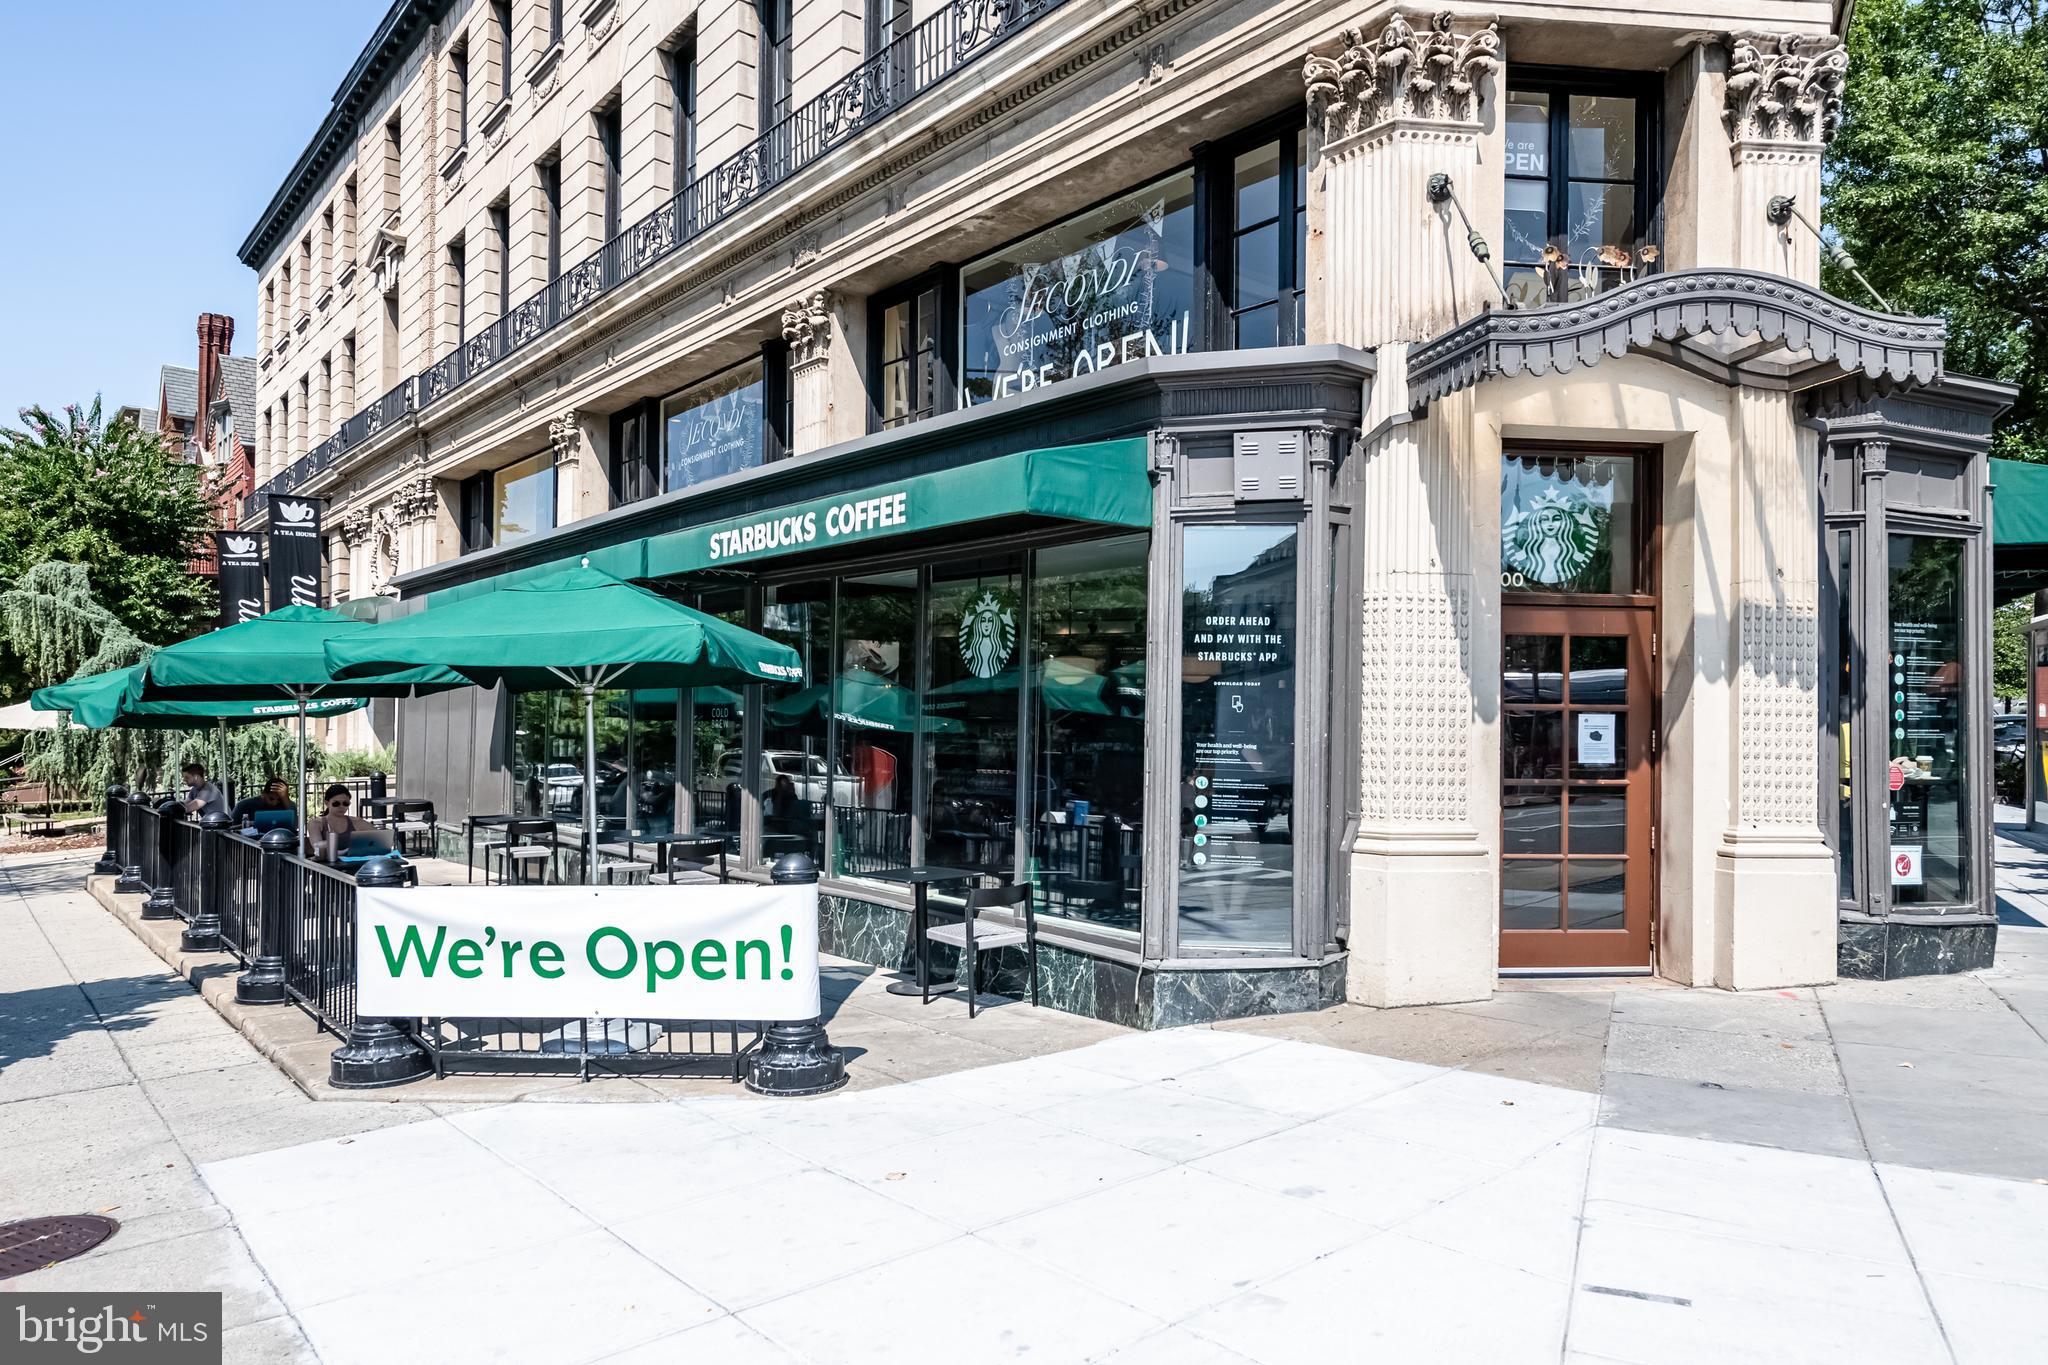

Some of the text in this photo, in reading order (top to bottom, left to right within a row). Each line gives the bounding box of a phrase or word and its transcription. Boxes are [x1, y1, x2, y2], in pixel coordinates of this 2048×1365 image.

[1517, 142, 1535, 151] are
[1504, 153, 1544, 172] PEN
[1003, 301, 1139, 357] CONSIGNMENT CLOTHING
[710, 492, 907, 560] STARBUCKS COFFEE
[1205, 616, 1270, 626] ORDER AHEAD
[1194, 634, 1282, 645] AND PAY WITH THE
[1259, 652, 1278, 662] APP
[253, 701, 319, 714] STARBUKS
[374, 924, 794, 993] We're Open!
